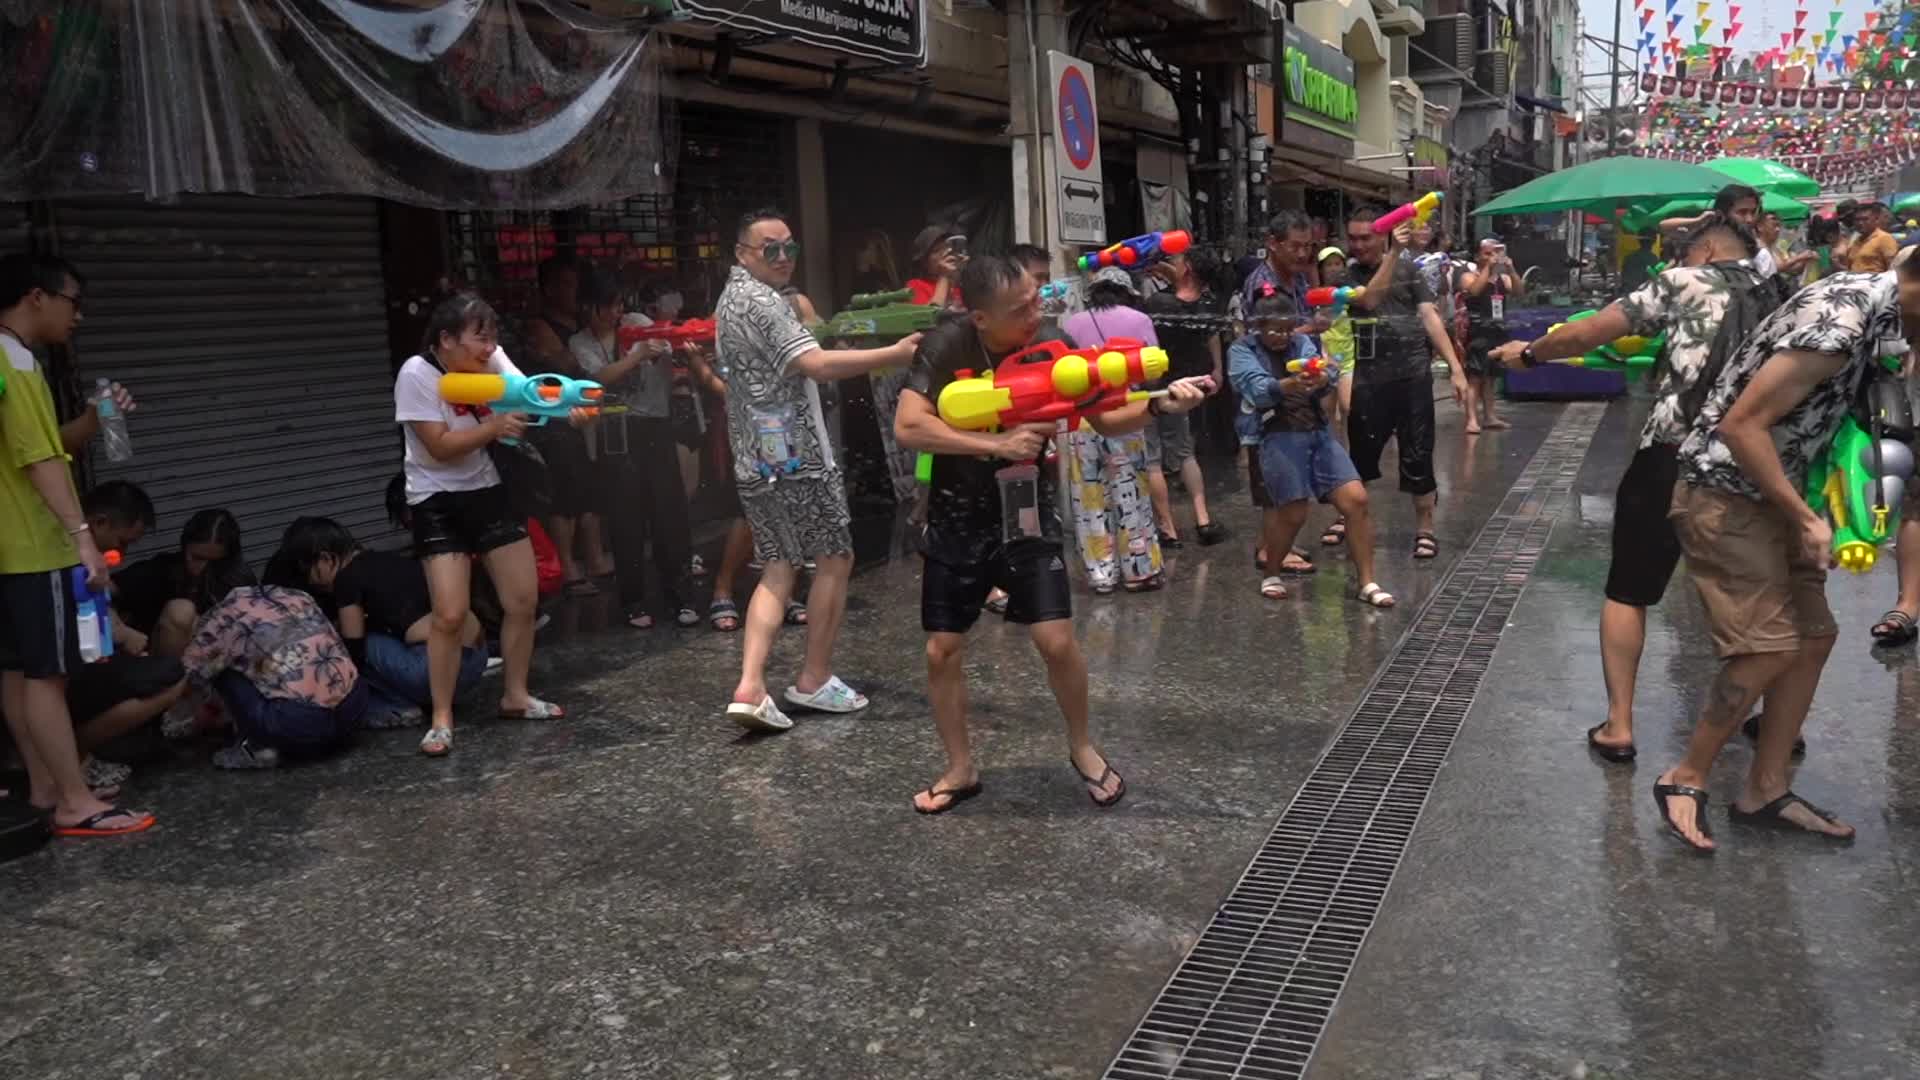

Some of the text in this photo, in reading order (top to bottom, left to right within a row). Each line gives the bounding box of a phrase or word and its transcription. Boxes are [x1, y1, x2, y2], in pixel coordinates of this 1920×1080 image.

[780, 0, 815, 20] Medical
[816, 7, 858, 31] Marijuana
[863, 18, 881, 37] Beer
